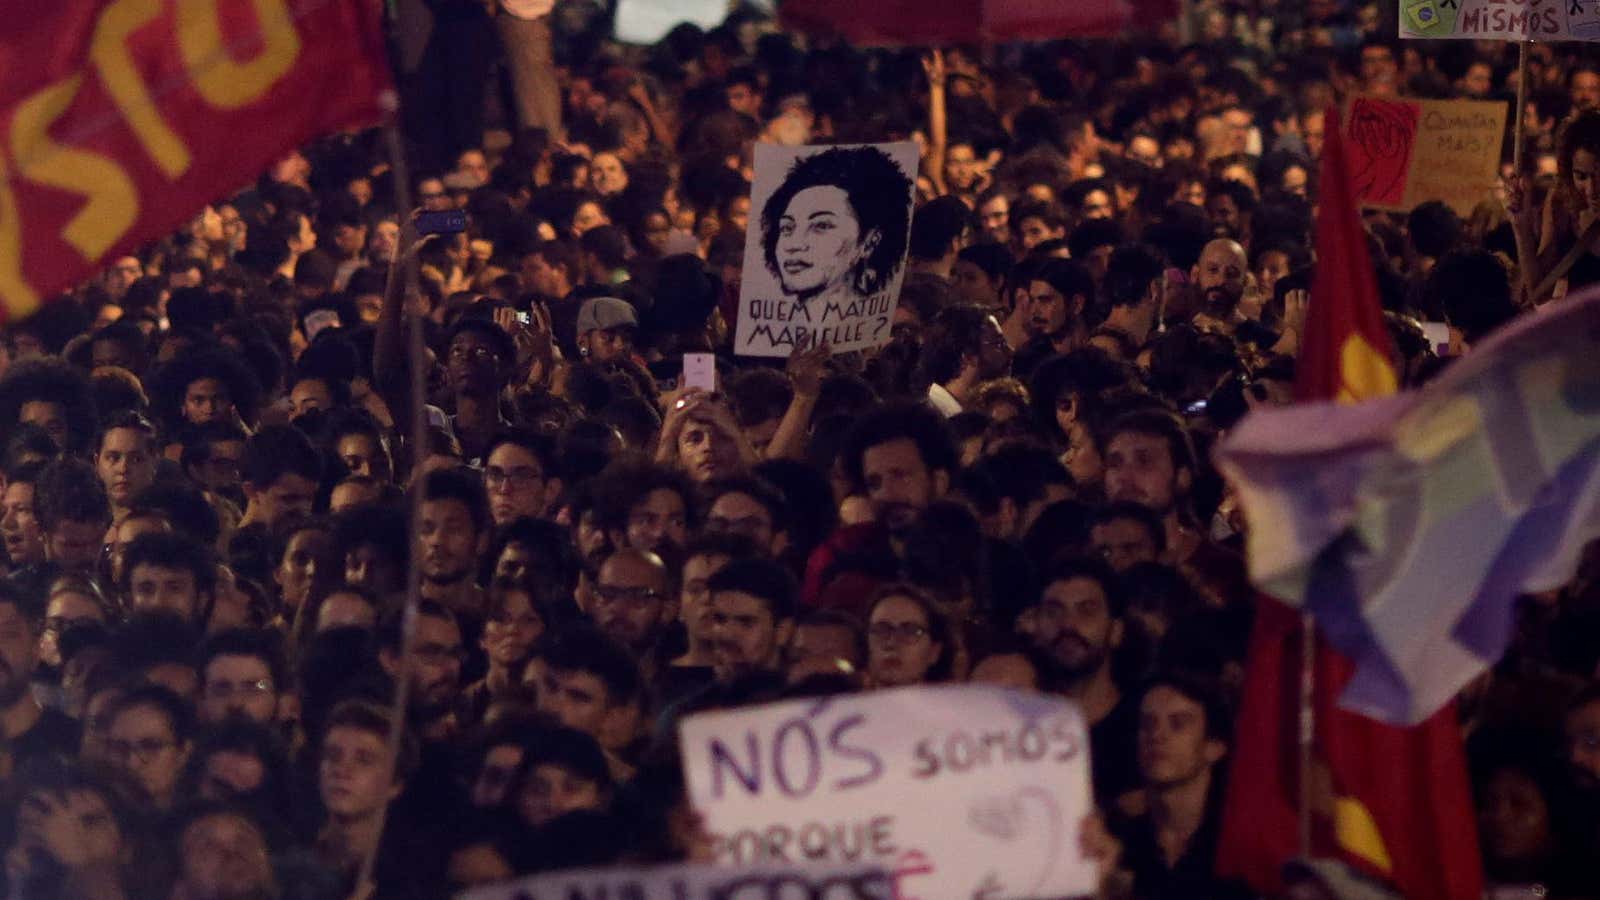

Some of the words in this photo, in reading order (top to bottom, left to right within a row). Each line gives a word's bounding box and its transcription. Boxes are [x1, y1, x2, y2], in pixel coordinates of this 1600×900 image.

[750, 298, 811, 322] QUEM
[821, 296, 891, 322] MATOU
[708, 696, 884, 799] NÓS
